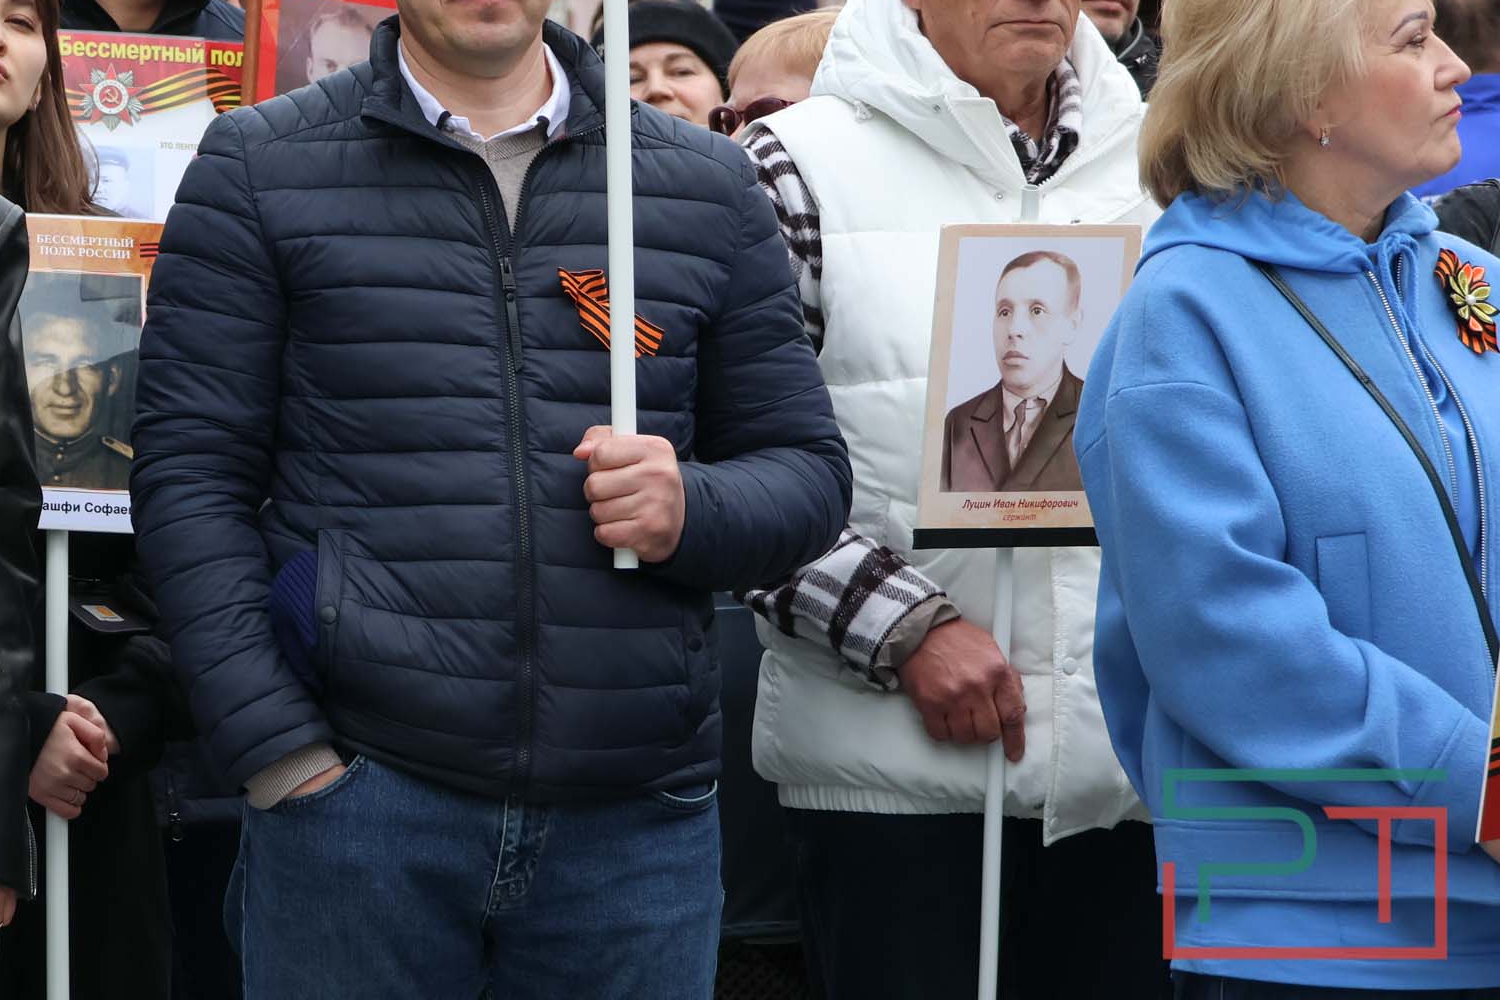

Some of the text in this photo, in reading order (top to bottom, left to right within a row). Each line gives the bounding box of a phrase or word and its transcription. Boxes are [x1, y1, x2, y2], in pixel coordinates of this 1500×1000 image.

[58, 34, 244, 67] Бессмертный пол
[36, 233, 134, 249] БЕССМЕРТНЫЙ
[40, 245, 132, 260] ПОЛК РОССИИ
[42, 501, 81, 514] ашфи
[993, 498, 1015, 508] Иван
[1018, 498, 1079, 510] Никифорович
